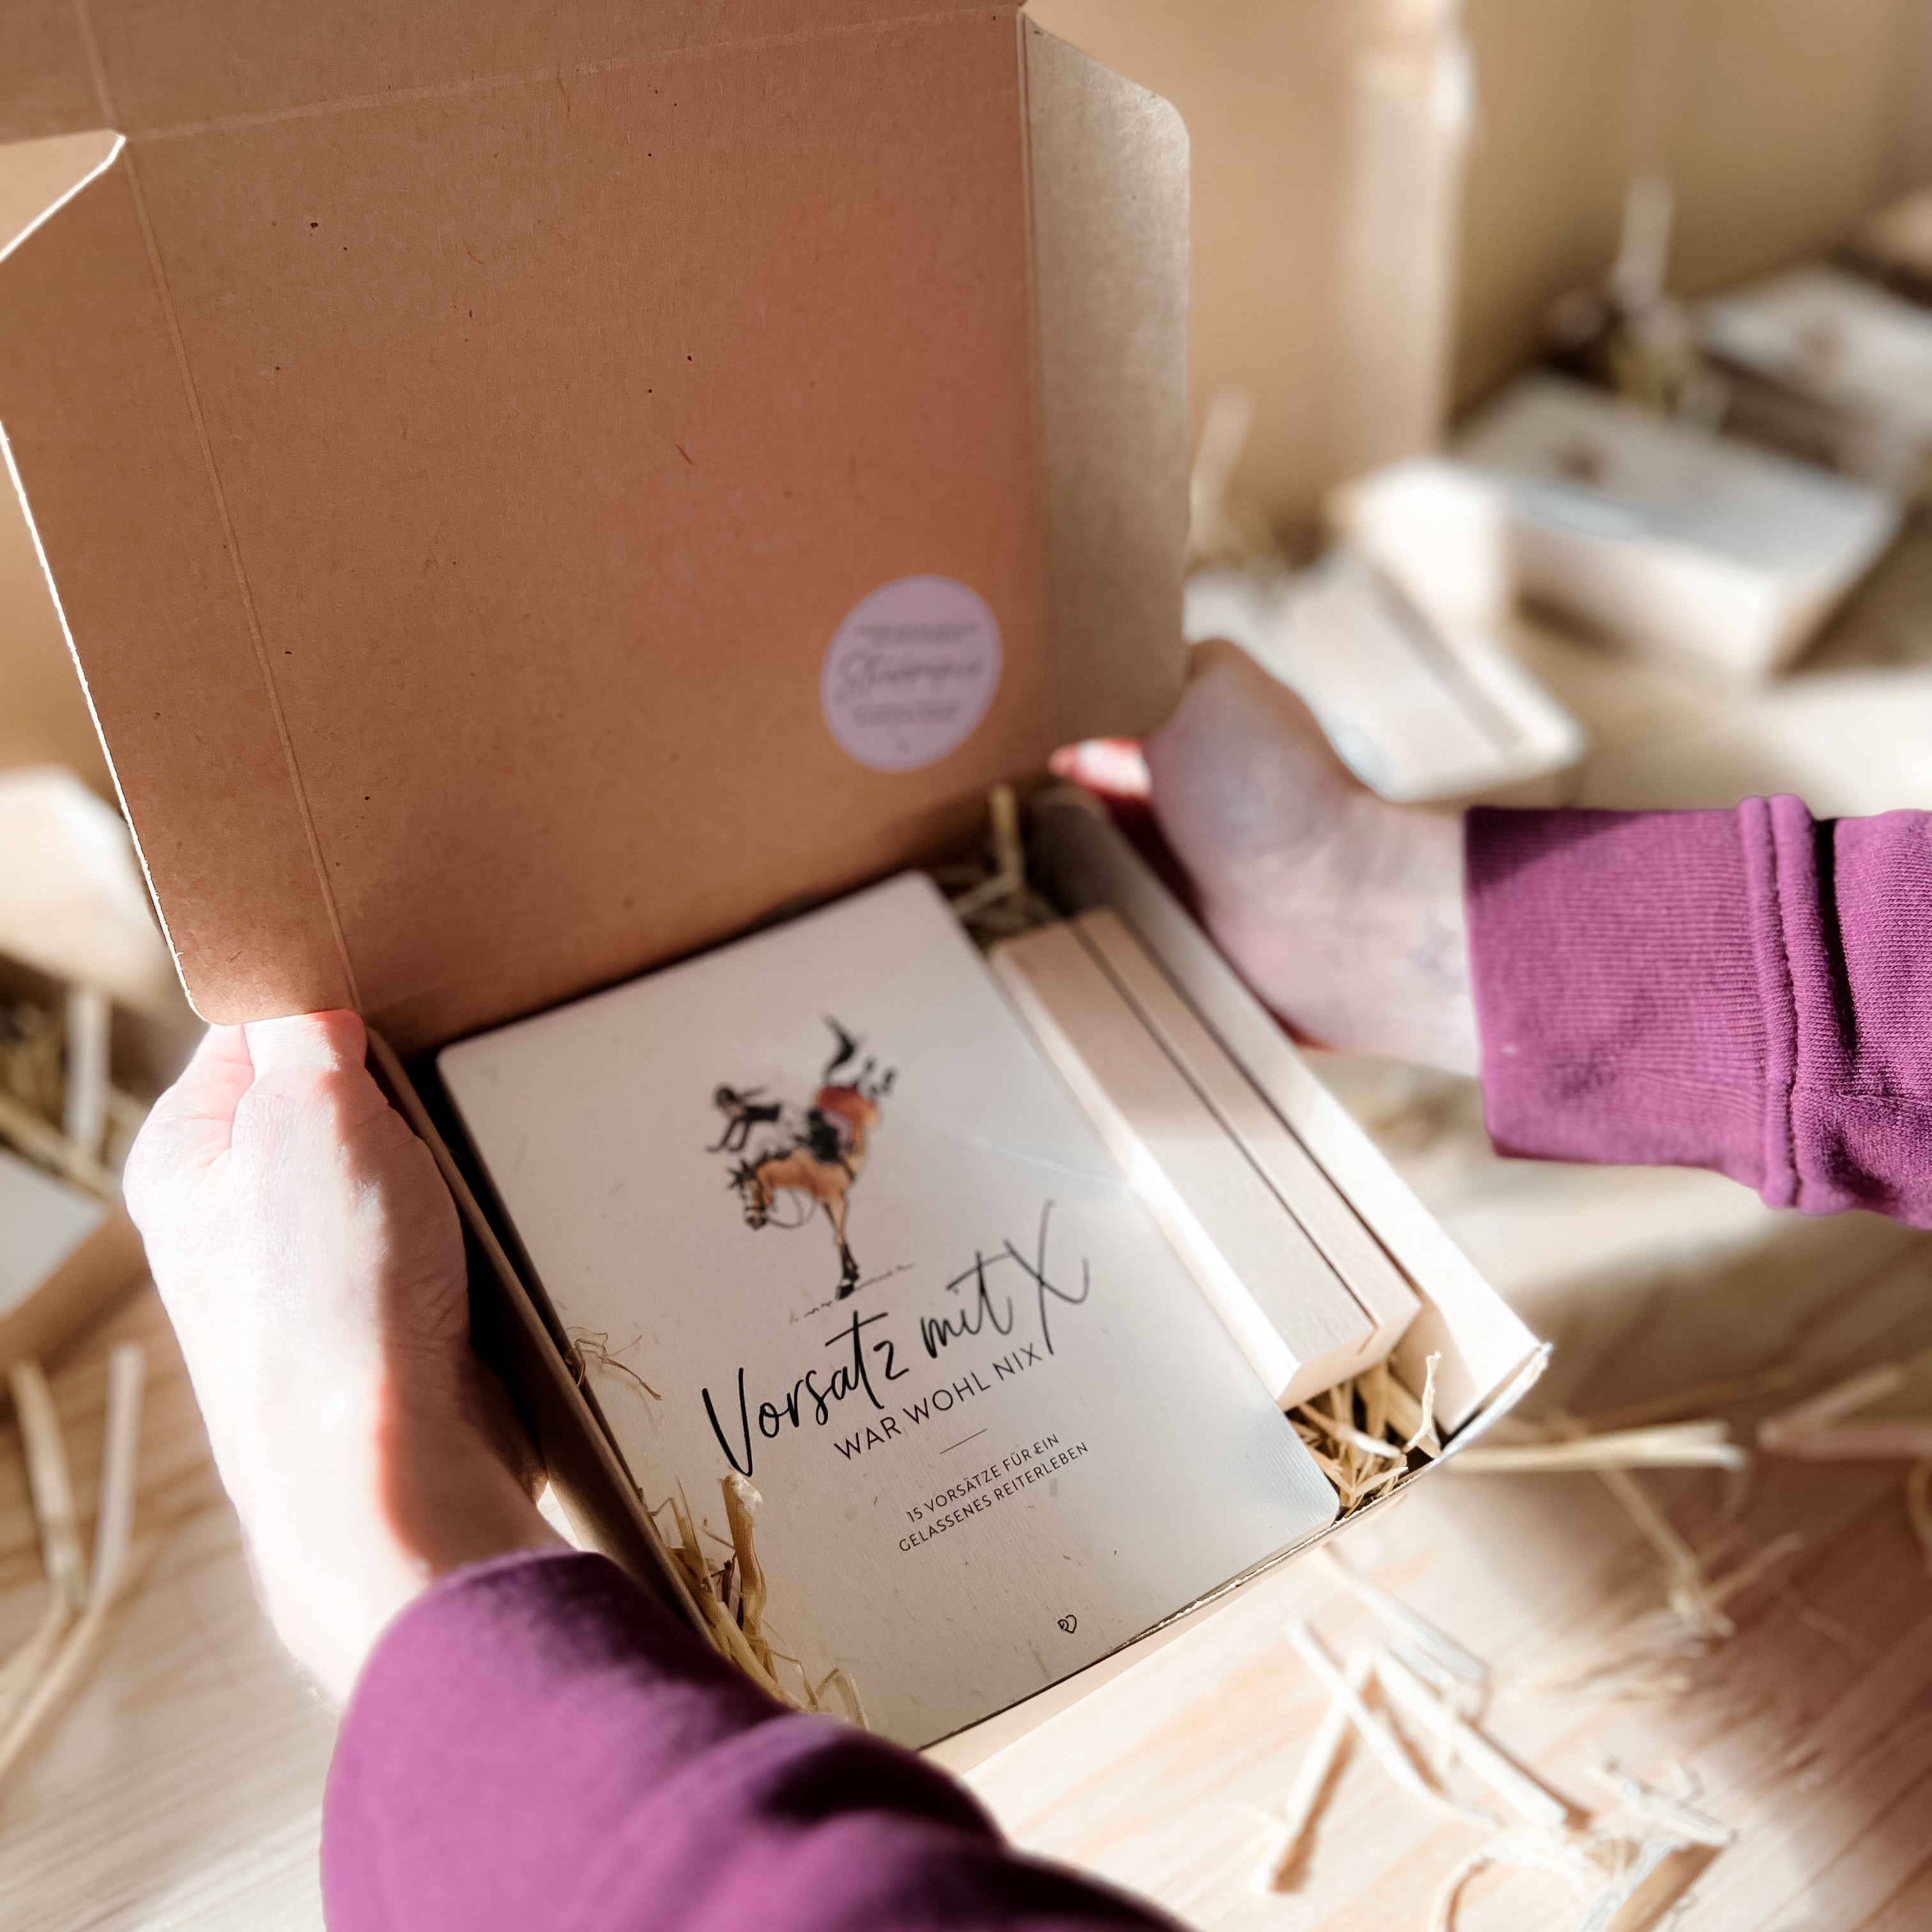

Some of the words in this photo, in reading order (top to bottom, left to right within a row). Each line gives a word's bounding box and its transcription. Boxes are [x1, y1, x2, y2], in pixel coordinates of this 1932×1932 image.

[702, 1310, 909, 1477] Vorsatz
[920, 1250, 1013, 1358] mit
[1003, 1199, 1090, 1355] X
[833, 1416, 902, 1460] WAR
[902, 1370, 992, 1425] WOHL
[992, 1342, 1043, 1381] NIX
[898, 1494, 992, 1552] GELASSENES
[993, 1441, 1089, 1501] REITERLEBEN
[906, 1506, 924, 1522] 15
[924, 1464, 1002, 1512] VORSÄTZE
[1002, 1451, 1032, 1472] FÜR
[1033, 1434, 1059, 1455] EIN
